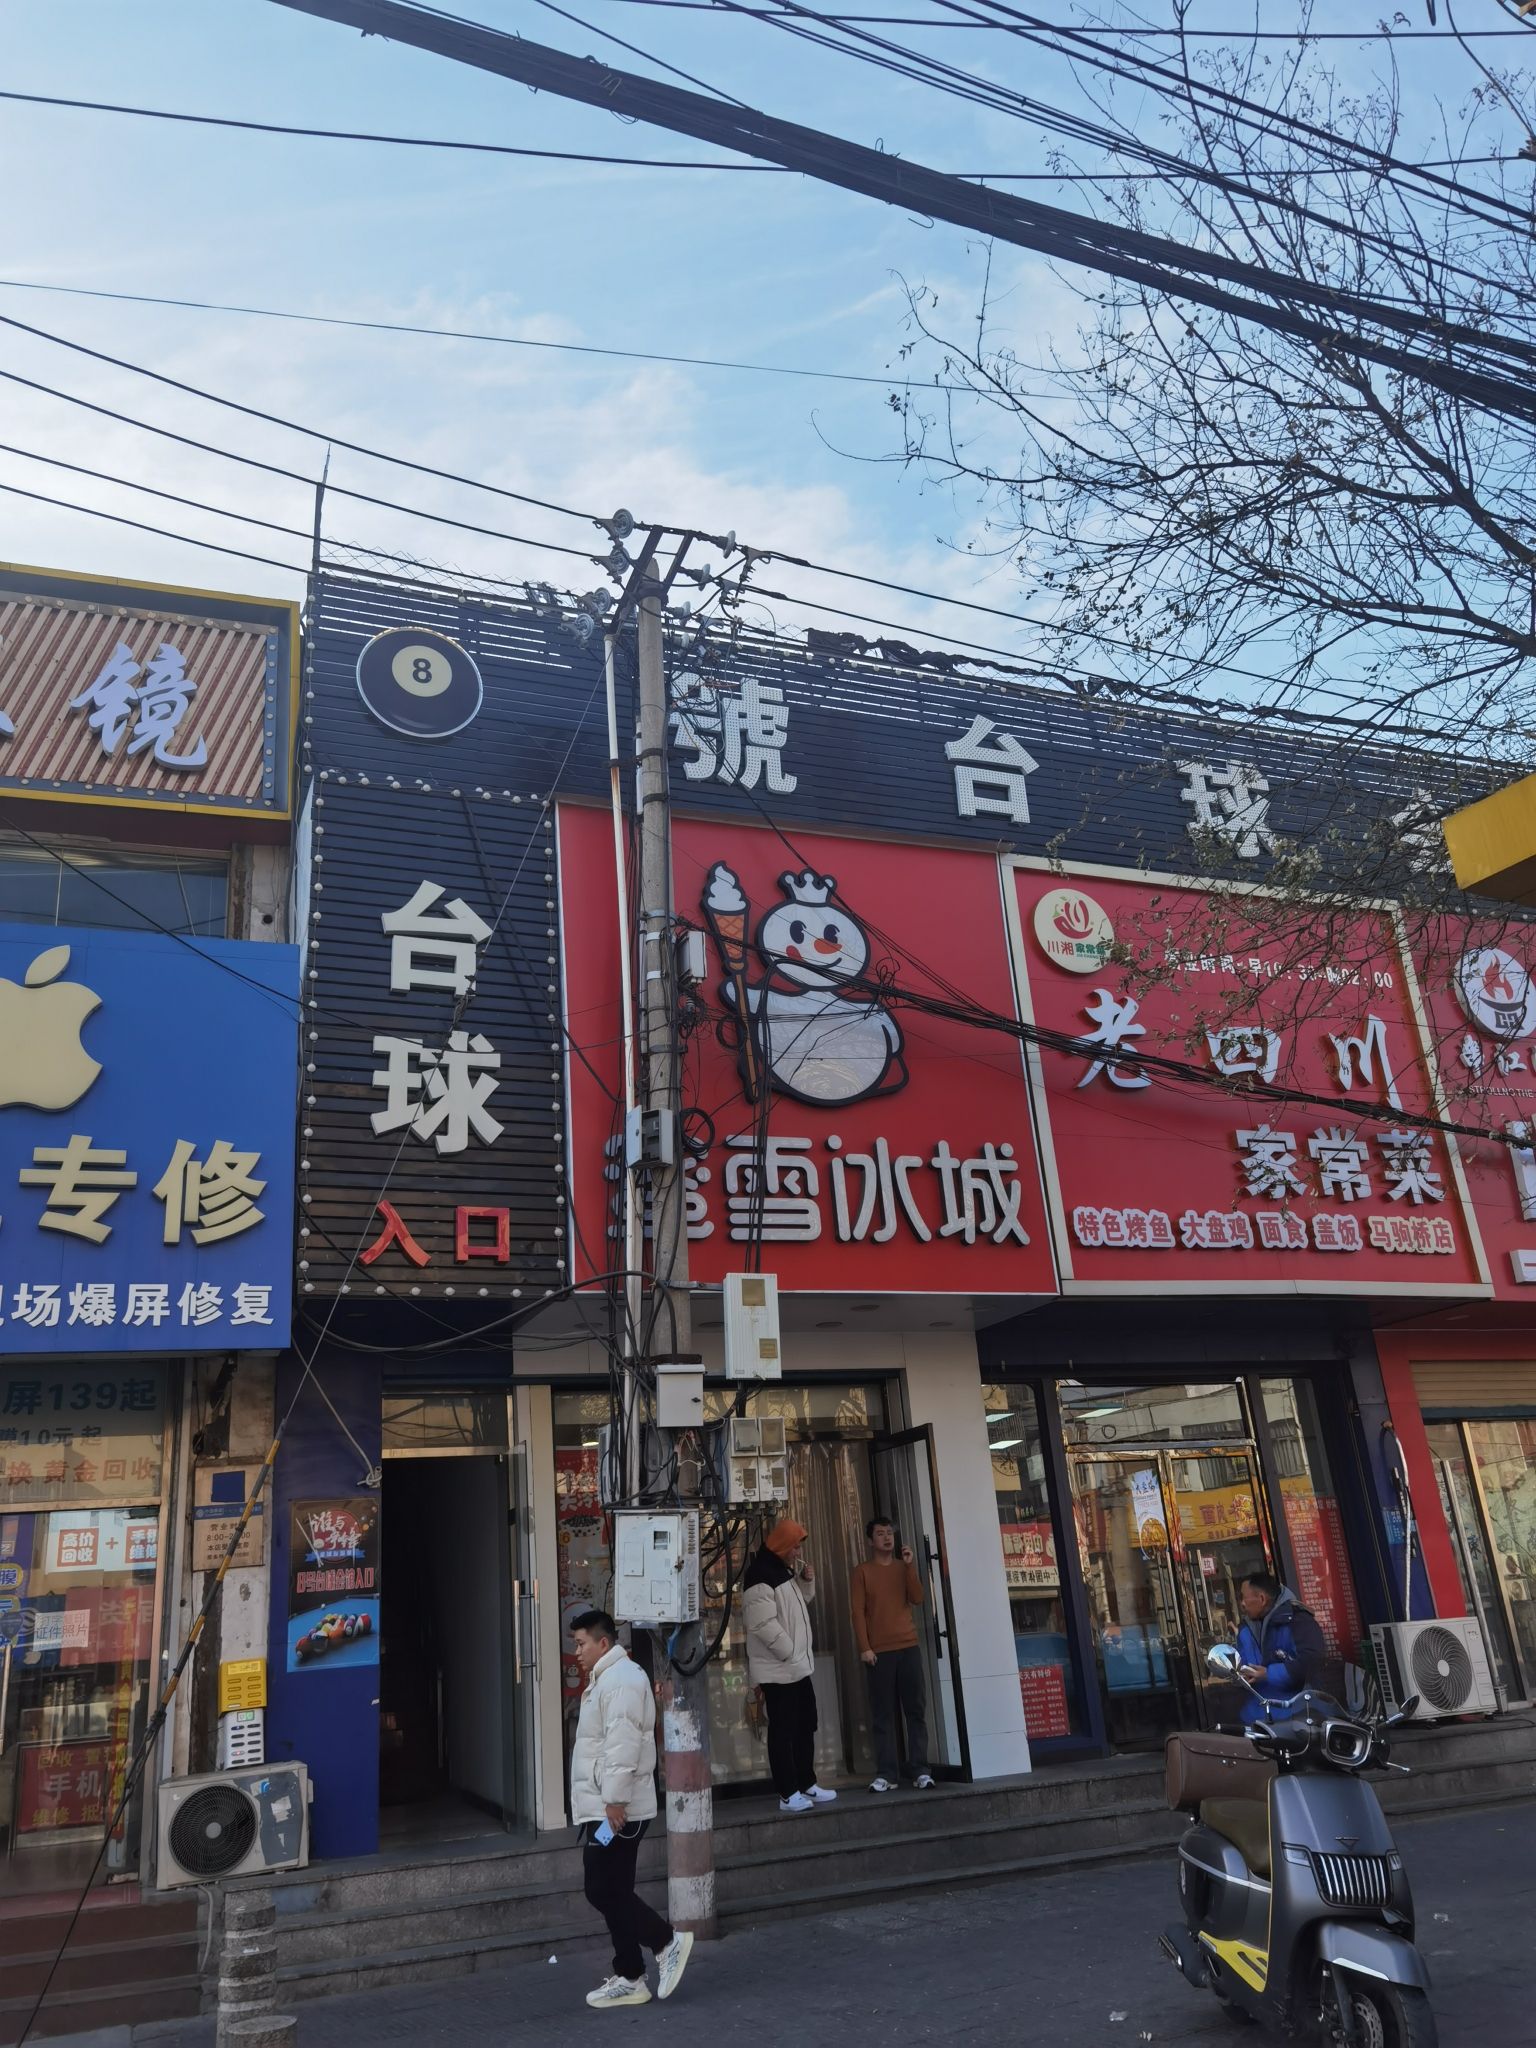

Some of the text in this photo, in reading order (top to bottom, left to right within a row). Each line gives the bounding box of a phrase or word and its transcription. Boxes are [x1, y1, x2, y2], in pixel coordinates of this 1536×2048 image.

[412, 658, 433, 685] 8
[0, 635, 207, 772] 镜
[370, 879, 505, 1155] 台球
[1075, 989, 1403, 1110] 老四川
[1234, 1124, 1445, 1205] 家常菜
[19, 1134, 268, 1246] 专修
[358, 1199, 510, 1267] 入口
[1075, 1208, 1454, 1252] 特色烤鱼 大盘鸡 面食 盖饭 马驹桥店
[0, 1282, 274, 1327] 场爆屏修复
[3, 1378, 158, 1415] 屏139起
[43, 1456, 157, 1484] 黄金回收
[61, 1548, 94, 1563] 回收
[62, 1531, 95, 1547] 高价
[49, 1770, 100, 1800] 手机
